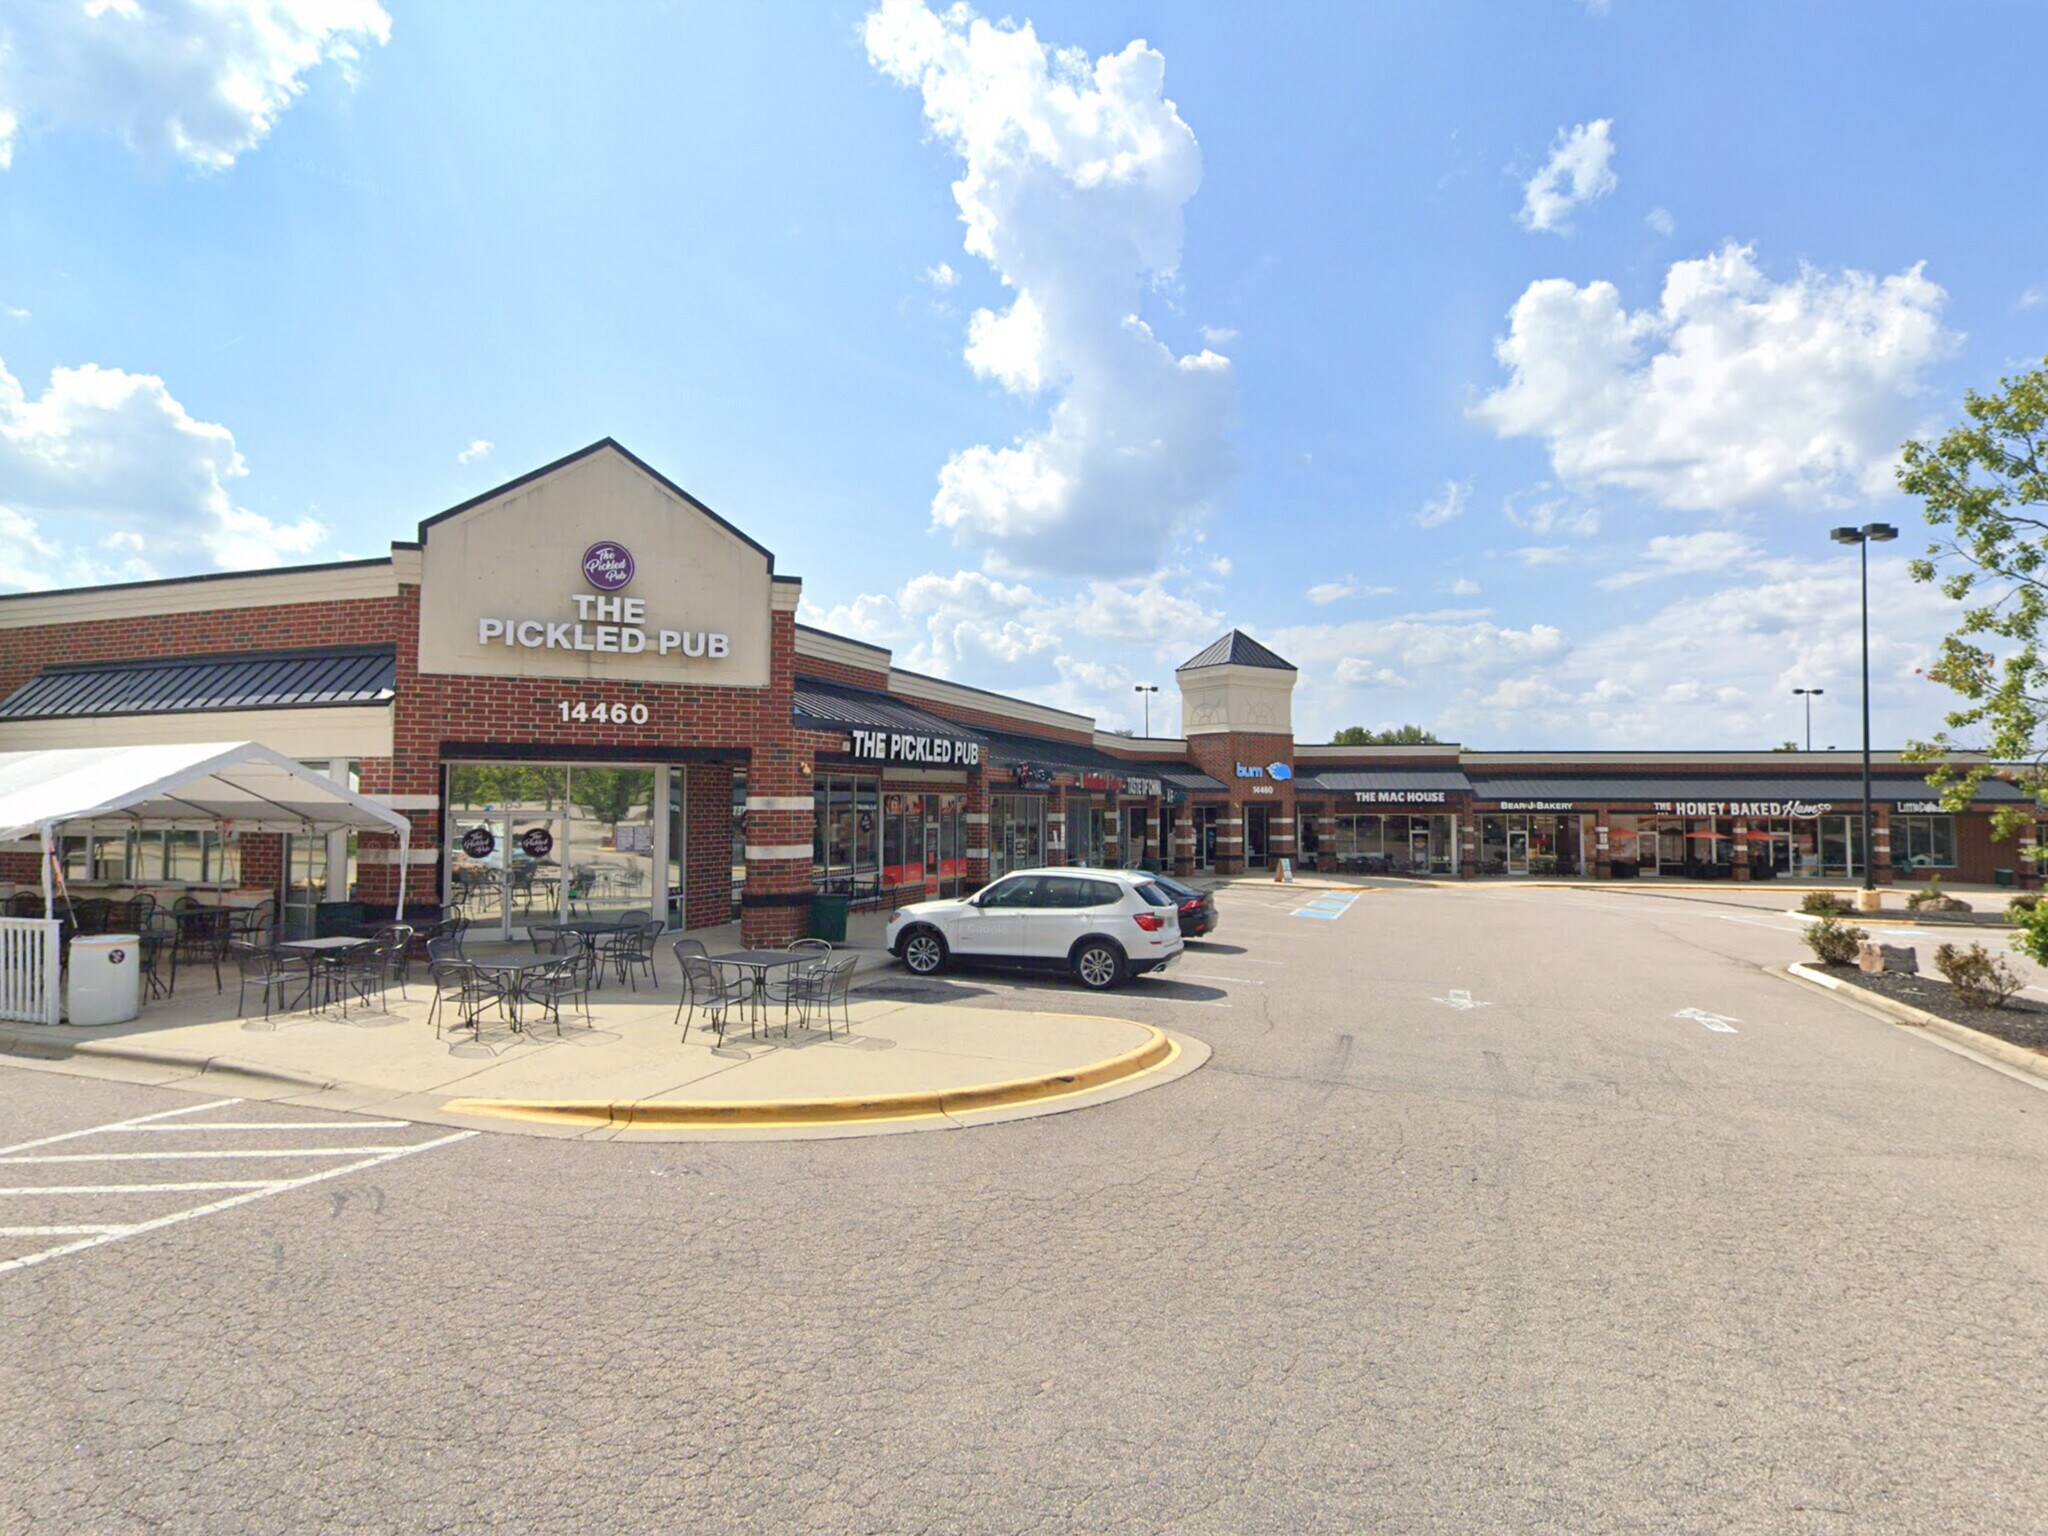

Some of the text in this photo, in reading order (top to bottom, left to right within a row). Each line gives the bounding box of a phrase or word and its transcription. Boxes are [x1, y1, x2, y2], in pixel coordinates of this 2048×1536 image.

[596, 547, 615, 561] The
[586, 558, 627, 573] Pickled
[605, 570, 627, 582] Pub
[572, 594, 646, 624] THE
[479, 618, 730, 658] PICKLED PUB
[558, 701, 650, 725] 14460
[853, 730, 979, 765] THE PICKLED PUB
[1235, 761, 1263, 778] burn
[1355, 792, 1445, 802] THE MAC HOUSE
[1654, 802, 1672, 811] THE
[1676, 802, 1726, 816] HONEY
[1730, 802, 1781, 816] BAKED
[1782, 800, 1820, 819] Ham
